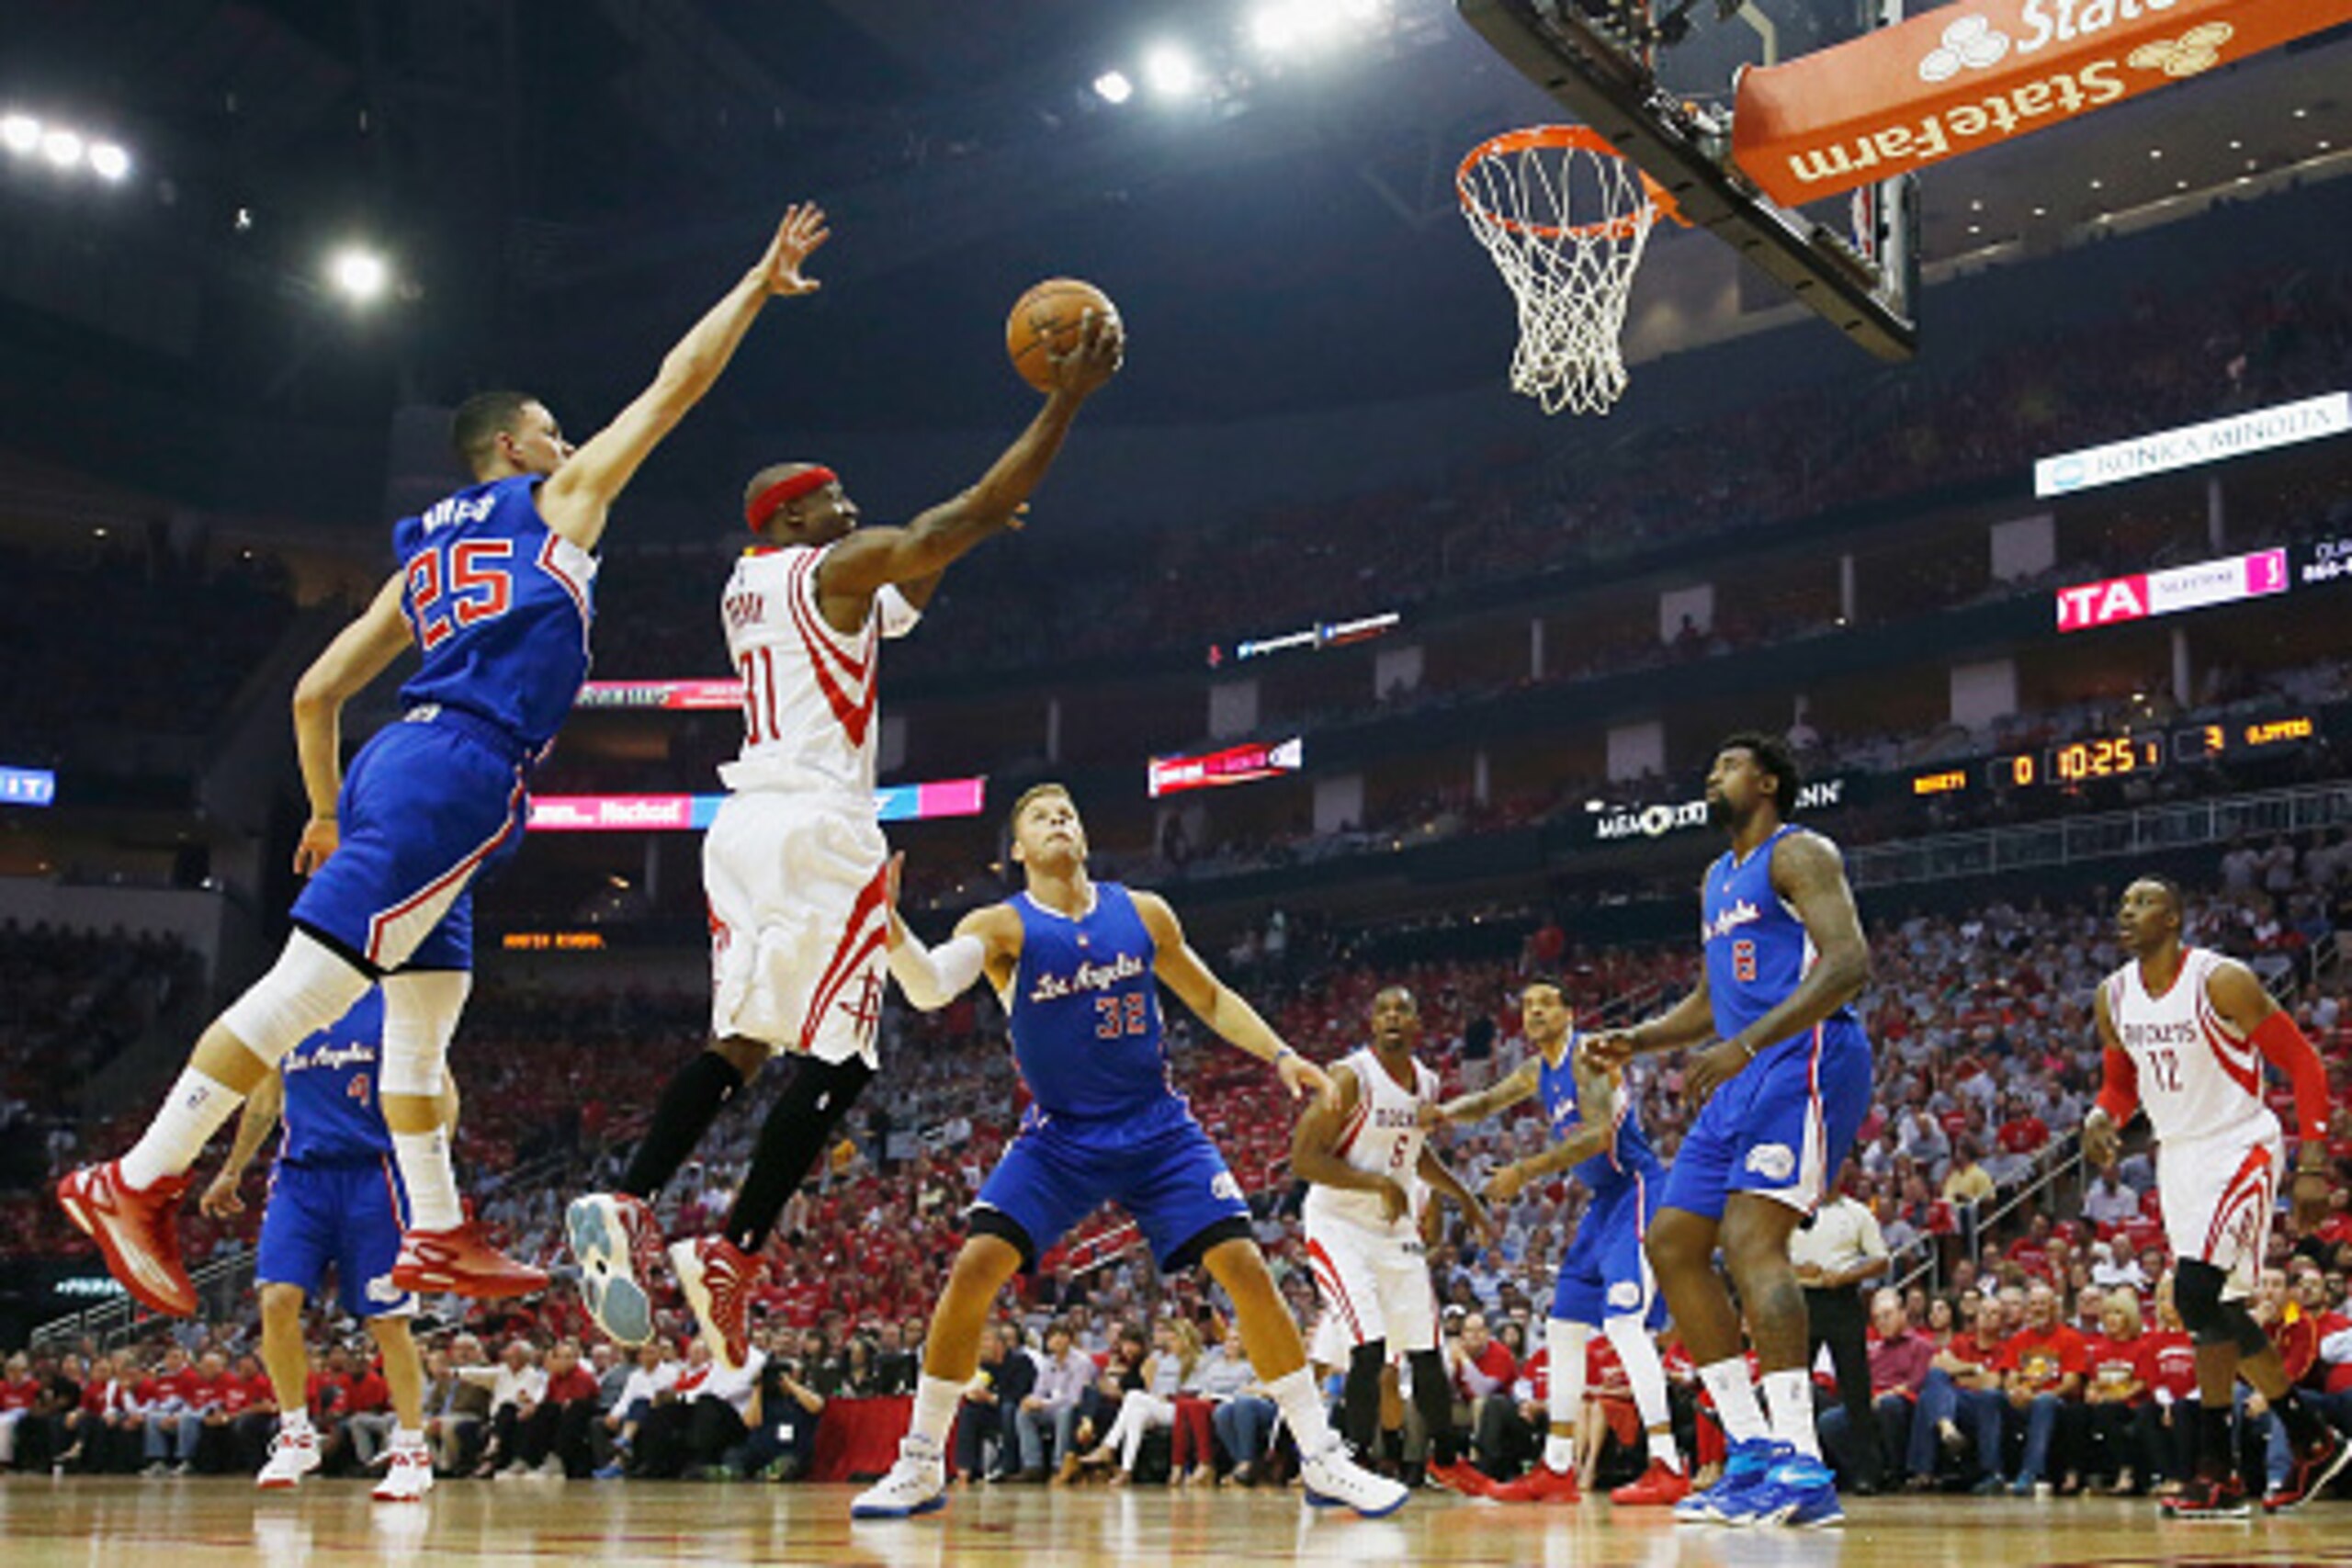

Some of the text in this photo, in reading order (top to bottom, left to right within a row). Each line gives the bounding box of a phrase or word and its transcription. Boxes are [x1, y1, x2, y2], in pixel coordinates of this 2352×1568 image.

[404, 538, 514, 651] 25
[2014, 755, 2033, 785] 0
[2058, 738, 2135, 779] 10:25
[1095, 993, 1147, 1039] 32
[2145, 1048, 2185, 1093] 12
